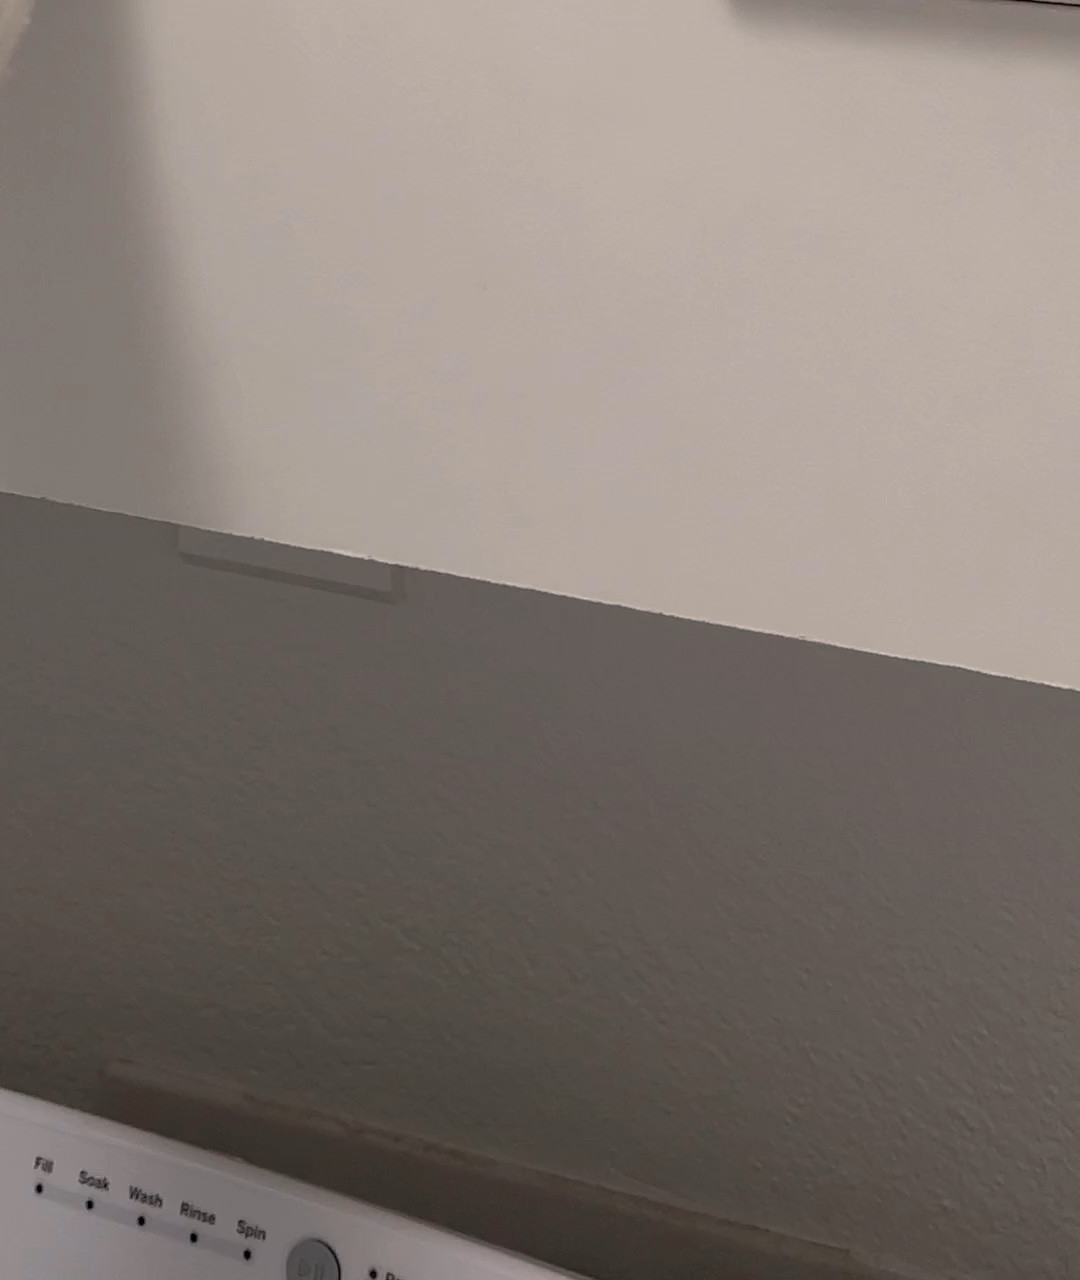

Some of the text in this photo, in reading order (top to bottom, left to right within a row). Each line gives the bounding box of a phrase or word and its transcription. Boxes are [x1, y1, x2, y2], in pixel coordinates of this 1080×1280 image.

[78, 1170, 110, 1191] Soak
[128, 1185, 163, 1209] Wash
[180, 1201, 216, 1225] Rinse
[236, 1219, 267, 1241] Spin
